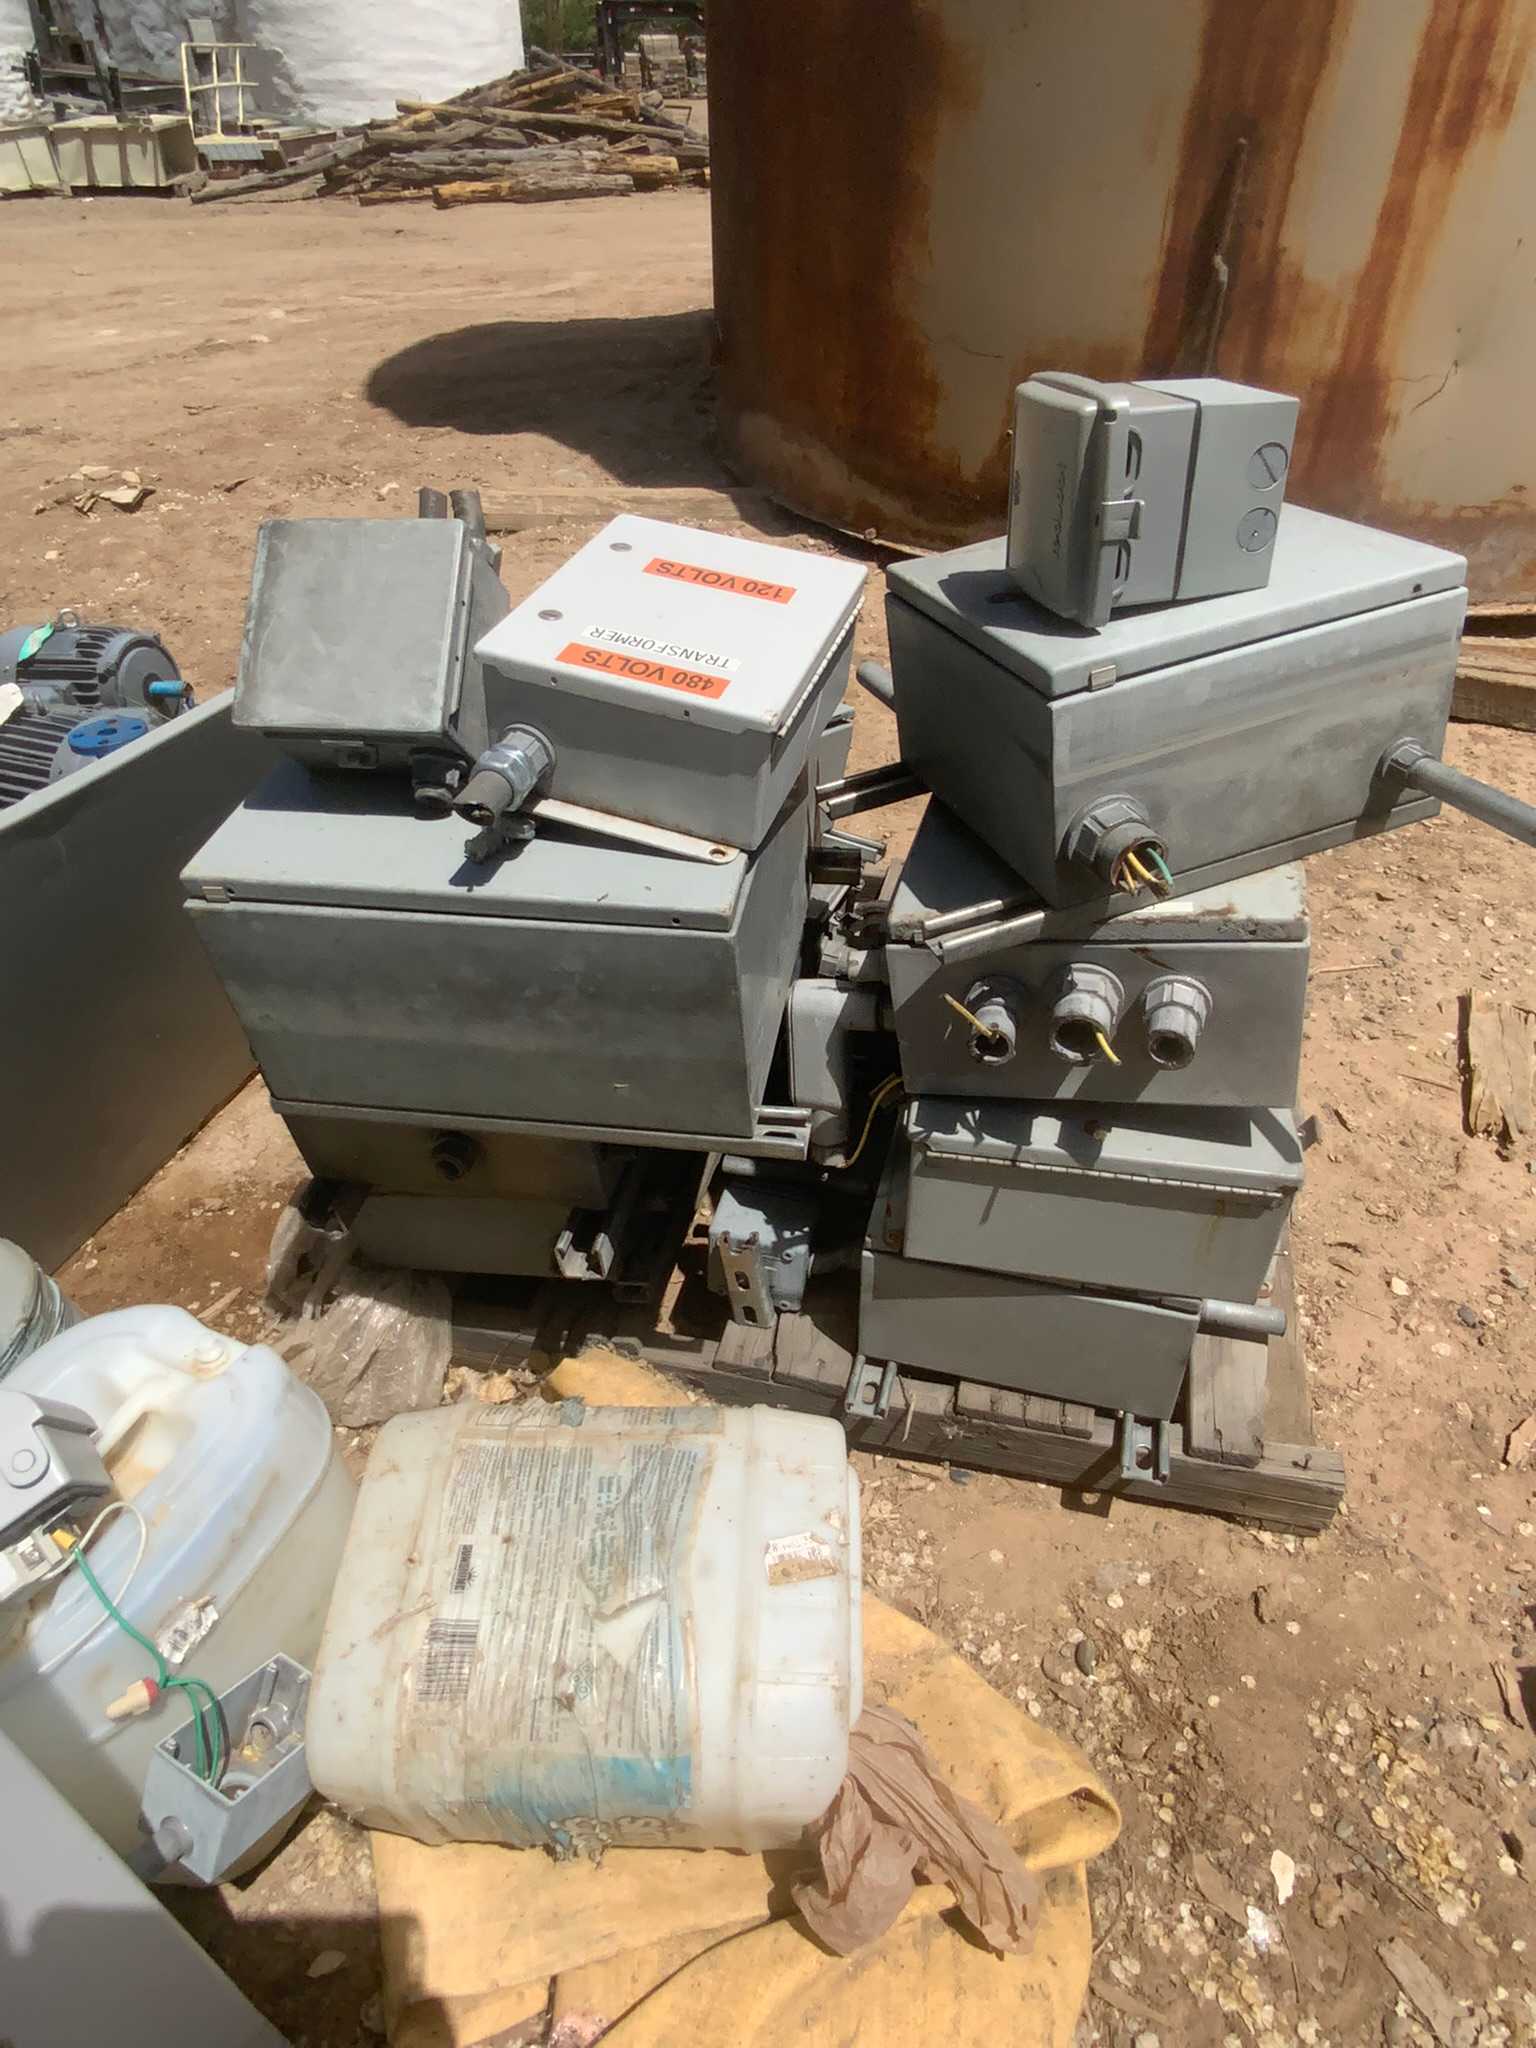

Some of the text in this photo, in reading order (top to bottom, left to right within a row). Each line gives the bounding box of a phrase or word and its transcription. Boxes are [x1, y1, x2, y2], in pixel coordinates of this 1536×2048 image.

[656, 561, 784, 599] 120 VOLTS
[589, 626, 730, 669] TRANSFORMER
[581, 650, 715, 691] 480 VOLTS
